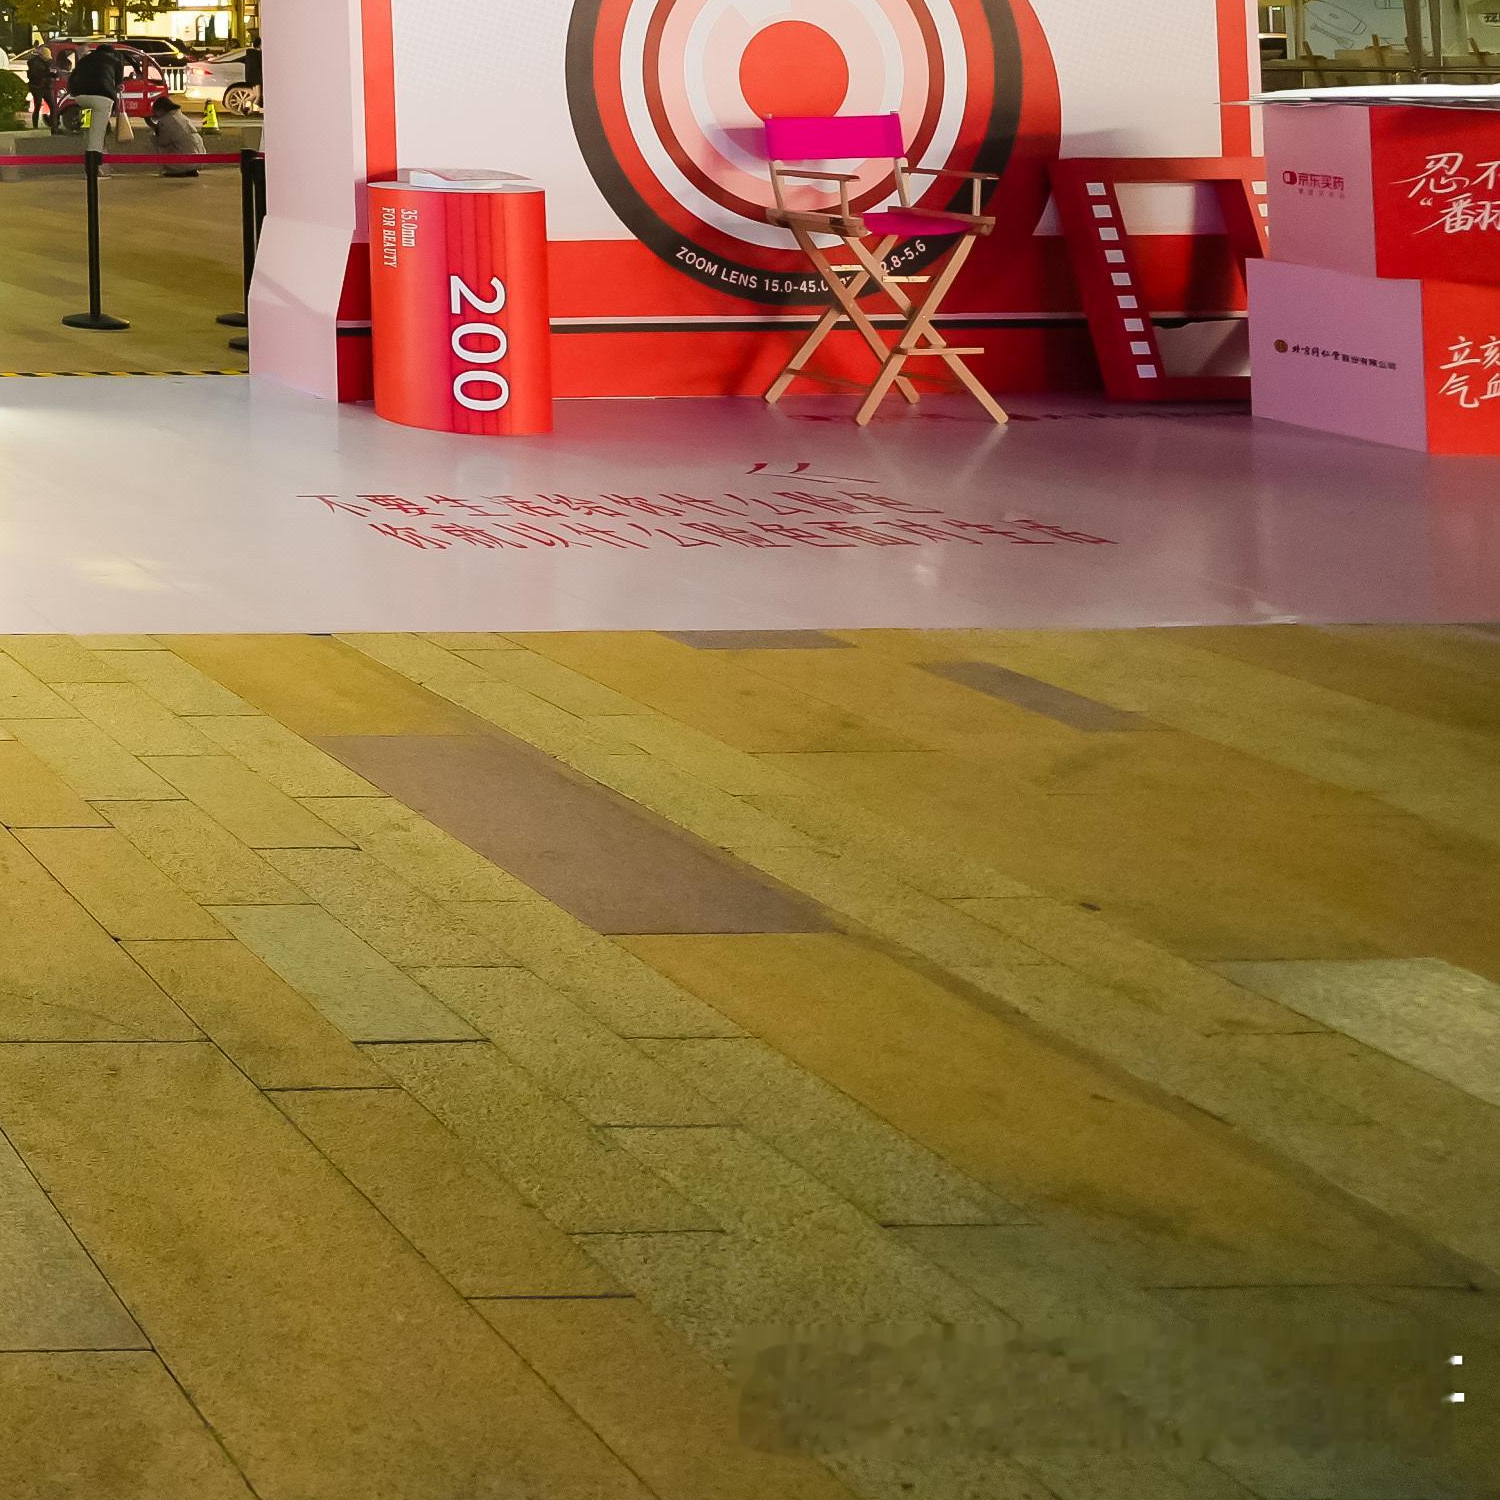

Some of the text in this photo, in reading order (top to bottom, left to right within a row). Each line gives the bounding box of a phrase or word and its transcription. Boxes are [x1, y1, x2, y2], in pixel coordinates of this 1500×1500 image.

[1298, 171, 1345, 192] 京东买药
[382, 206, 398, 269] FOR BEAUTY
[400, 208, 418, 248] 35.0mm
[675, 246, 717, 276] ZOOM
[720, 267, 758, 289] LENS
[450, 275, 510, 412] 200
